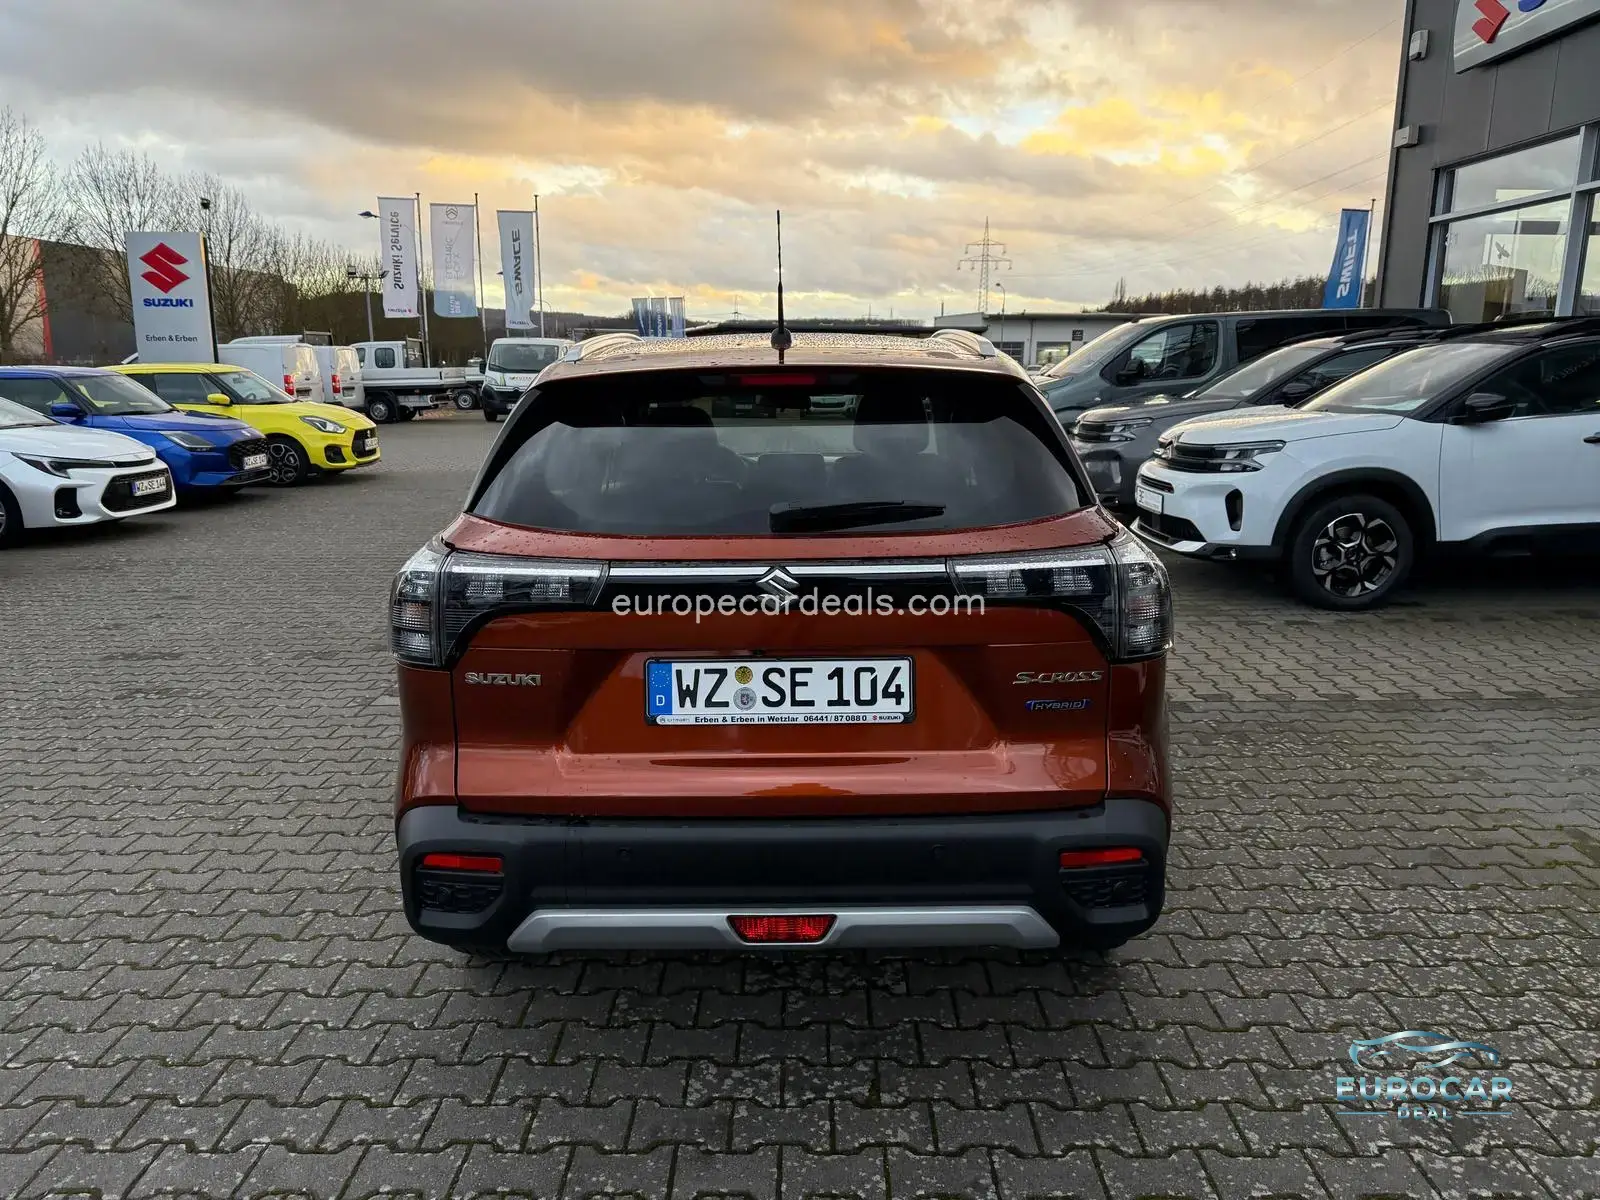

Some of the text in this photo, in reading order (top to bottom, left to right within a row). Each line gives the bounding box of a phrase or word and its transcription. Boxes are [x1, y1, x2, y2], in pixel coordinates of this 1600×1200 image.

[143, 297, 194, 308] SUZUKI
[145, 334, 167, 342] Erben
[168, 334, 174, 342] &
[464, 672, 542, 686] SUZUKI
[675, 666, 905, 708] WZ SE 104
[655, 694, 666, 706] D
[1034, 701, 1083, 710] HYBRID
[757, 715, 765, 723] in
[767, 715, 799, 723] Wetzlar
